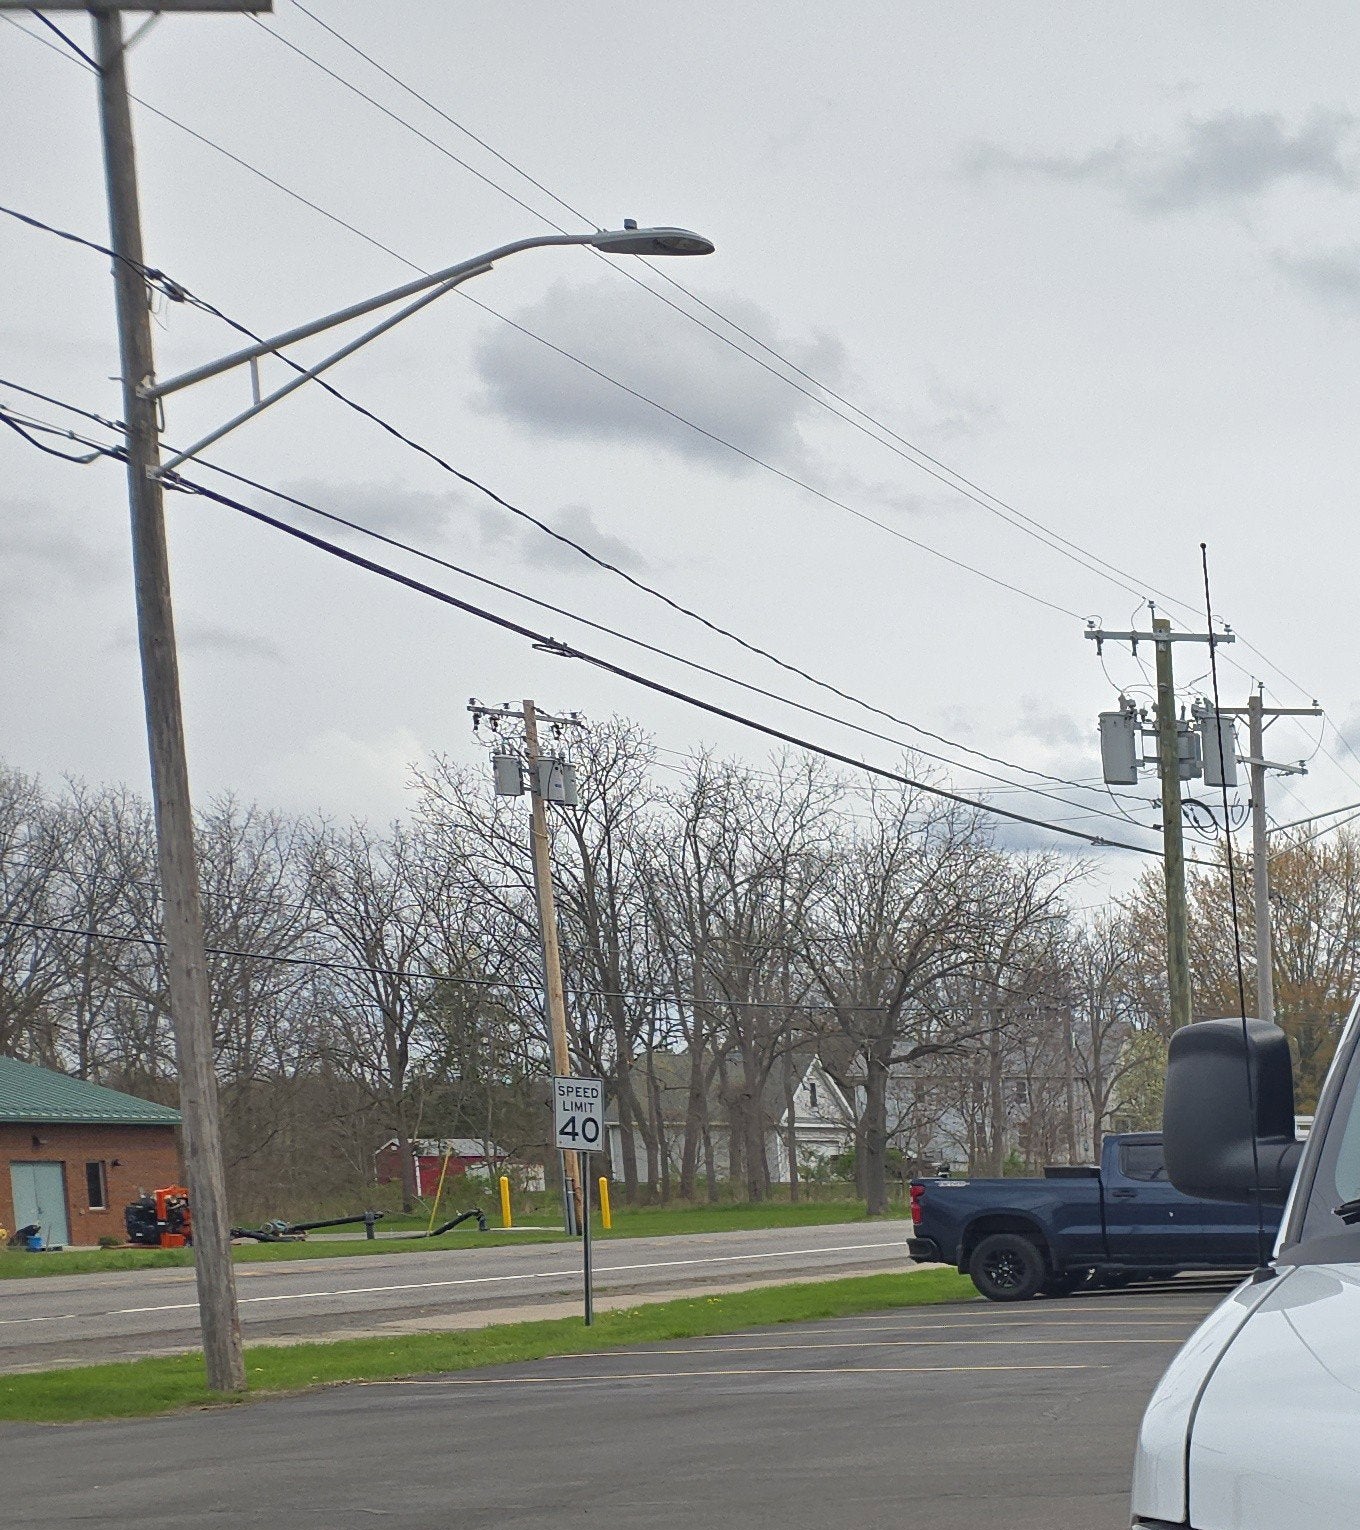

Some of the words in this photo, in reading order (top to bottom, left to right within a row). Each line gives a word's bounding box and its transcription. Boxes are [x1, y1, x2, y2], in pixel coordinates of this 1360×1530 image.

[558, 1085, 599, 1099] SPEED
[562, 1100, 595, 1113] LIMIT
[558, 1115, 600, 1143] 40
